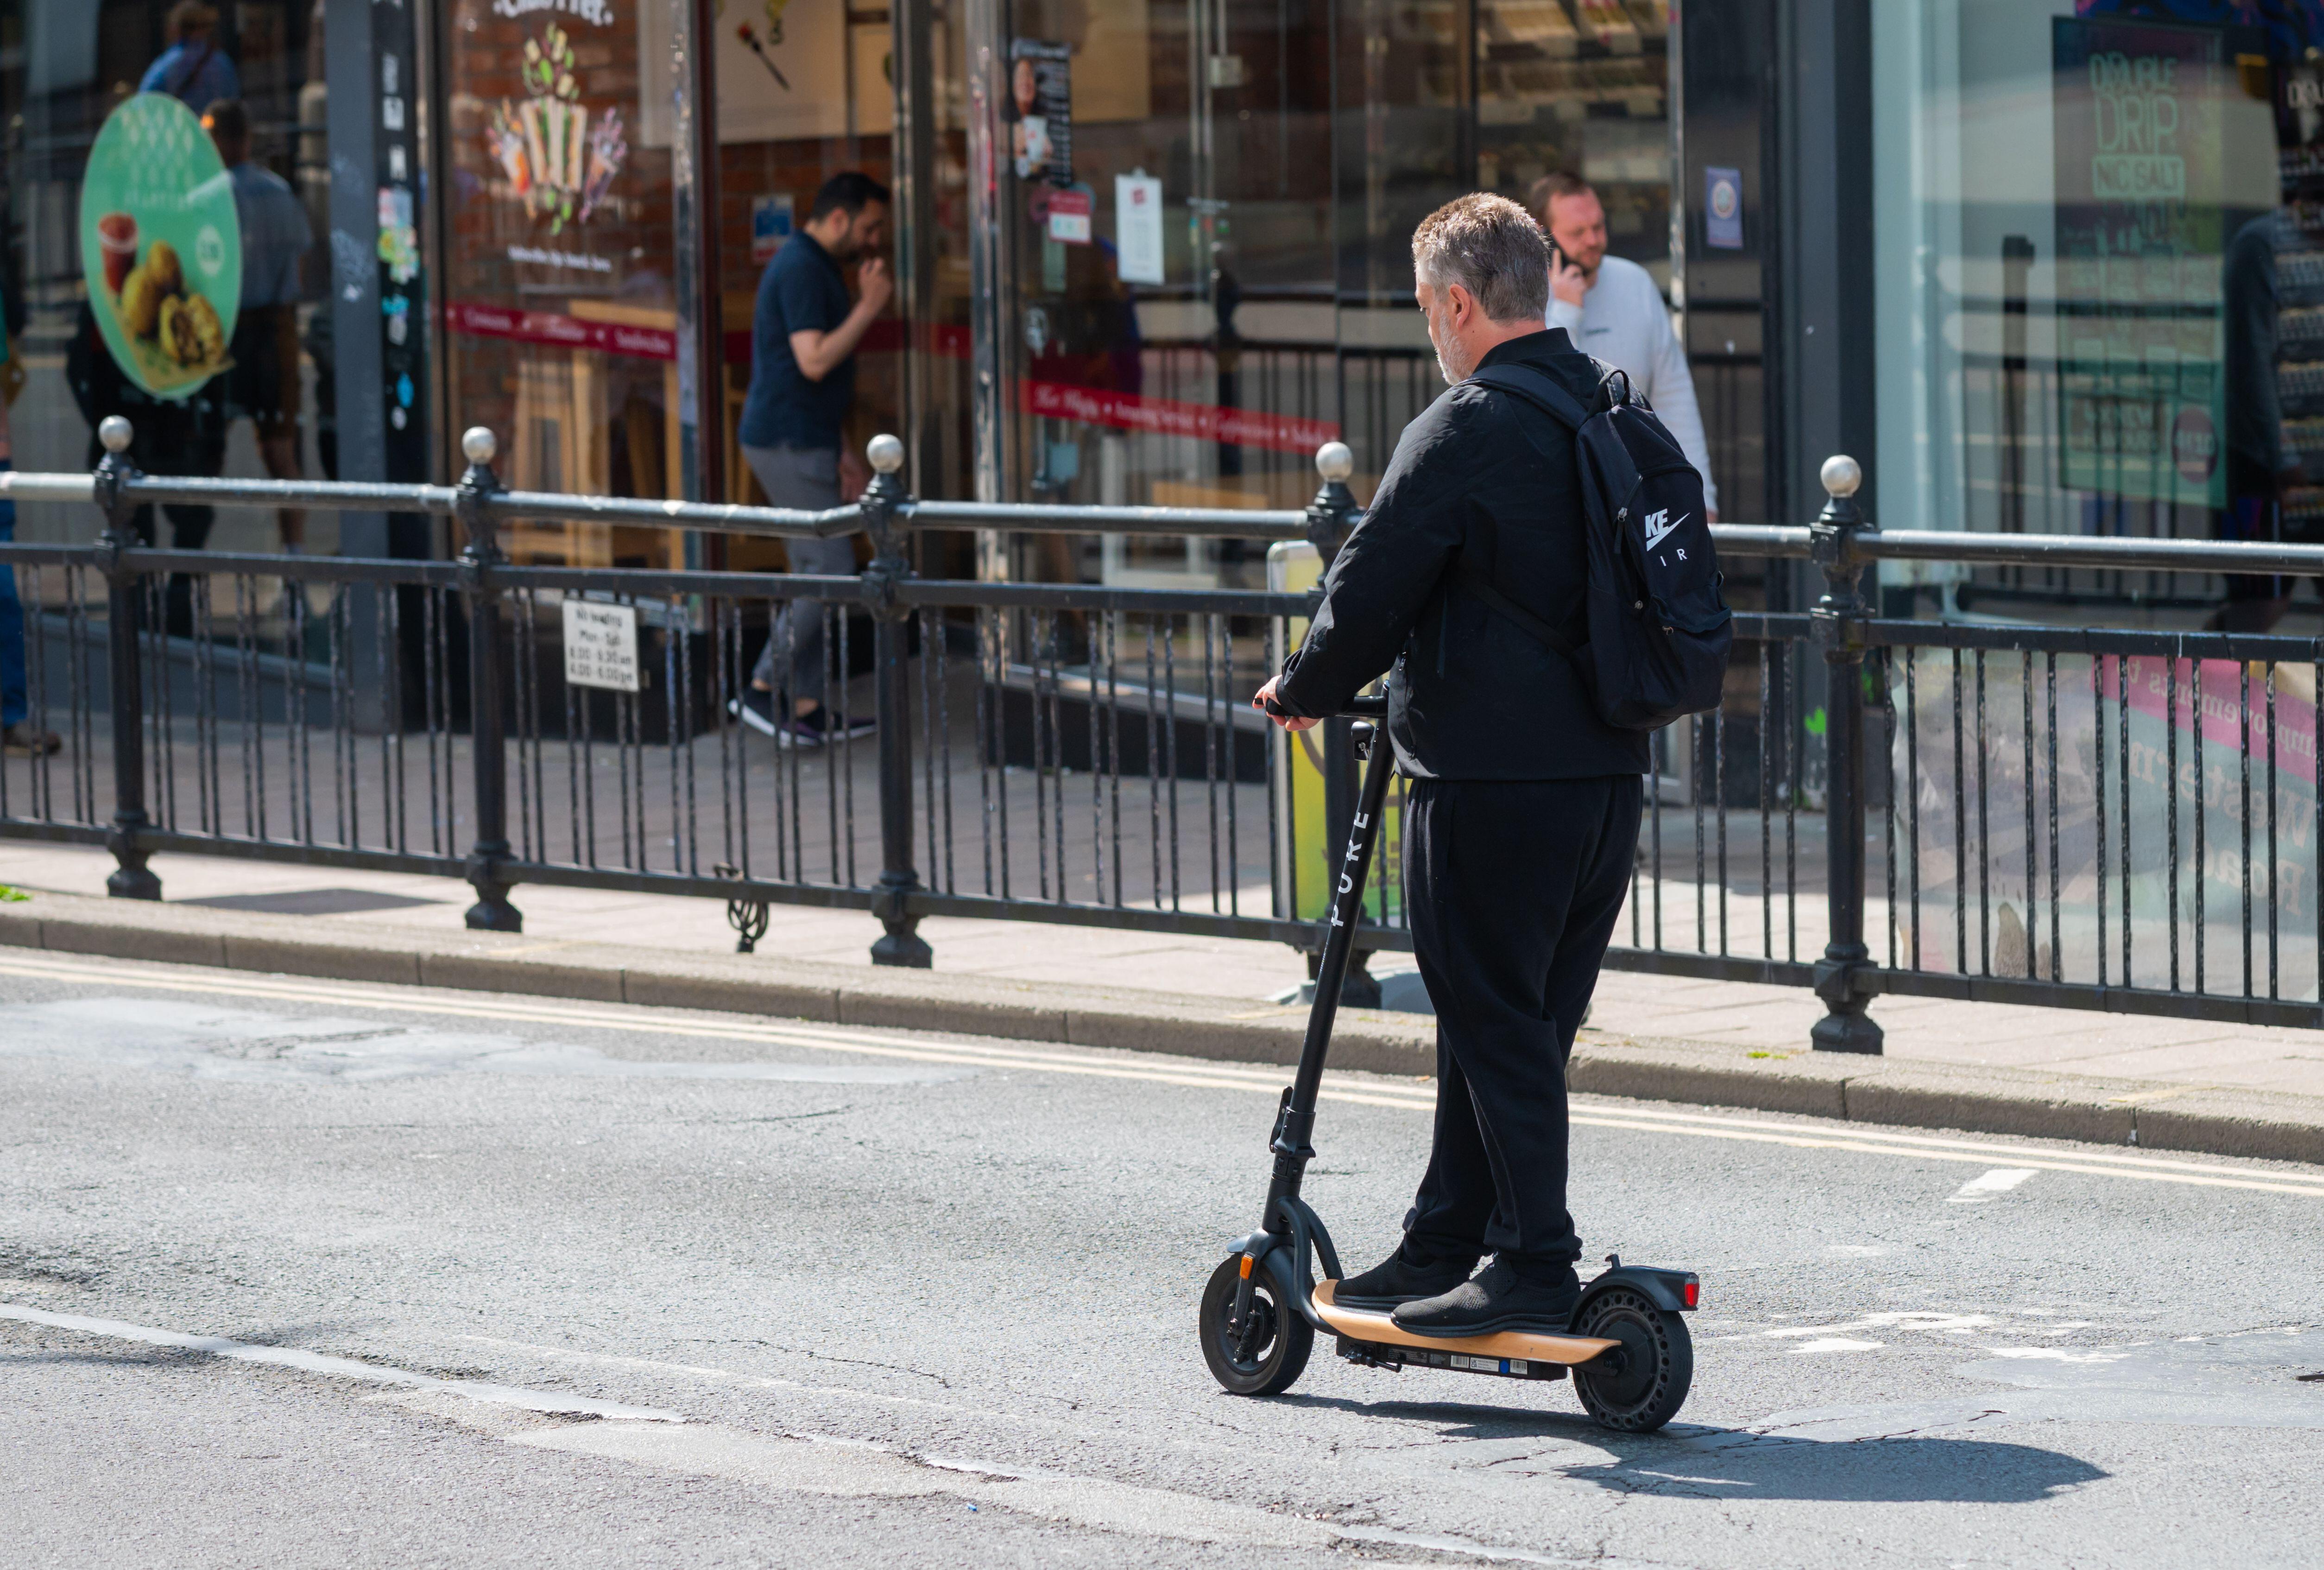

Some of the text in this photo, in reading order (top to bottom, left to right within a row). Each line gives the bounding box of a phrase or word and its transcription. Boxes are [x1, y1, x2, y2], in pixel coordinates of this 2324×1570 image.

[1645, 508, 1669, 538] KE
[1660, 548, 1687, 566] IR
[1331, 812, 1369, 927] PURE
